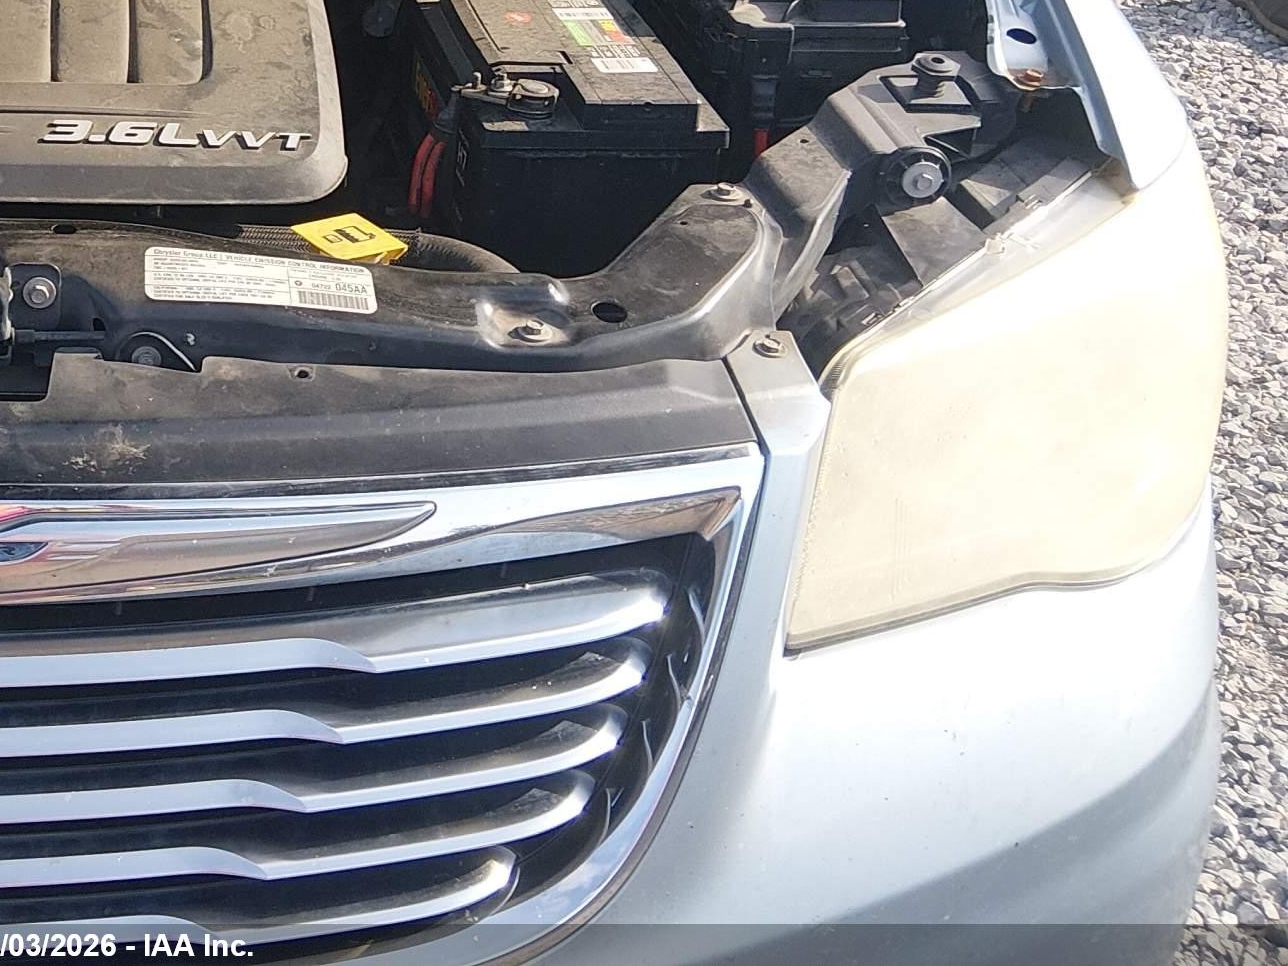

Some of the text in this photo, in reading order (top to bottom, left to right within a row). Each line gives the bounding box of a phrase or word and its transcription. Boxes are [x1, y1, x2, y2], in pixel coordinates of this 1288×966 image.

[153, 248, 181, 256] Chrysler
[184, 250, 203, 258] Group
[224, 254, 252, 262] VEHICLE
[255, 257, 285, 265] EMISSION
[288, 260, 317, 269] CONTROL
[320, 264, 365, 273] INFORMATION
